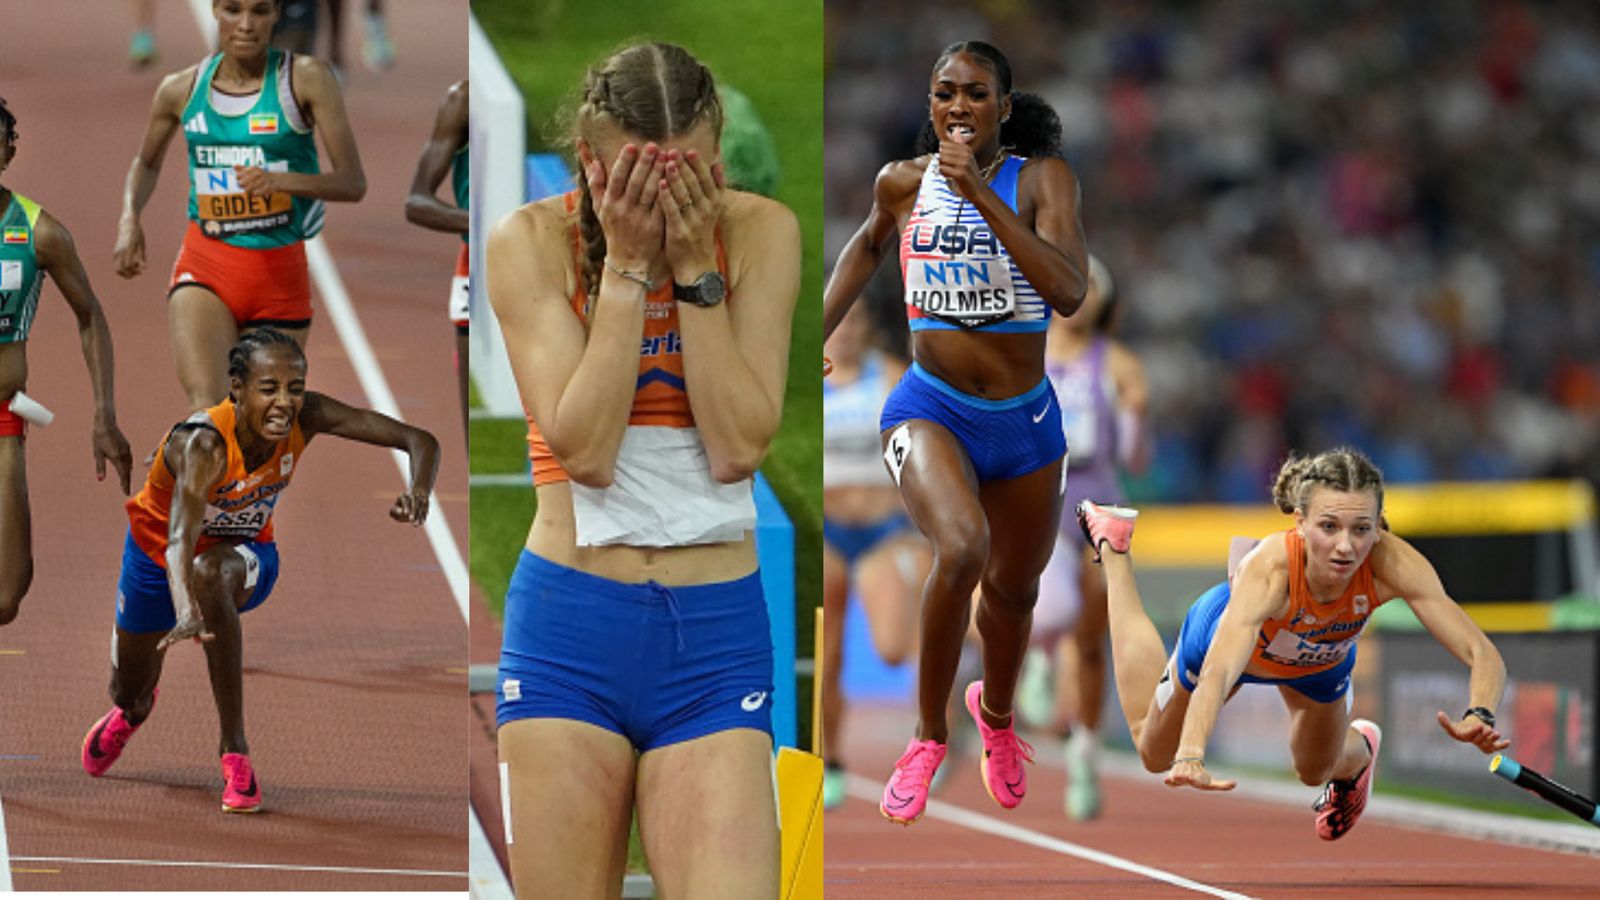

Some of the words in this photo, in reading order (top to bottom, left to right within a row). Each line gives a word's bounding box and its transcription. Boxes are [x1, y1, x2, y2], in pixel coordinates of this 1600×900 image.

[195, 145, 265, 167] ETHIOPIA
[211, 194, 272, 217] GIDEY
[912, 225, 999, 255] USA
[923, 262, 990, 285] NTN
[912, 288, 1008, 312] HOLMES
